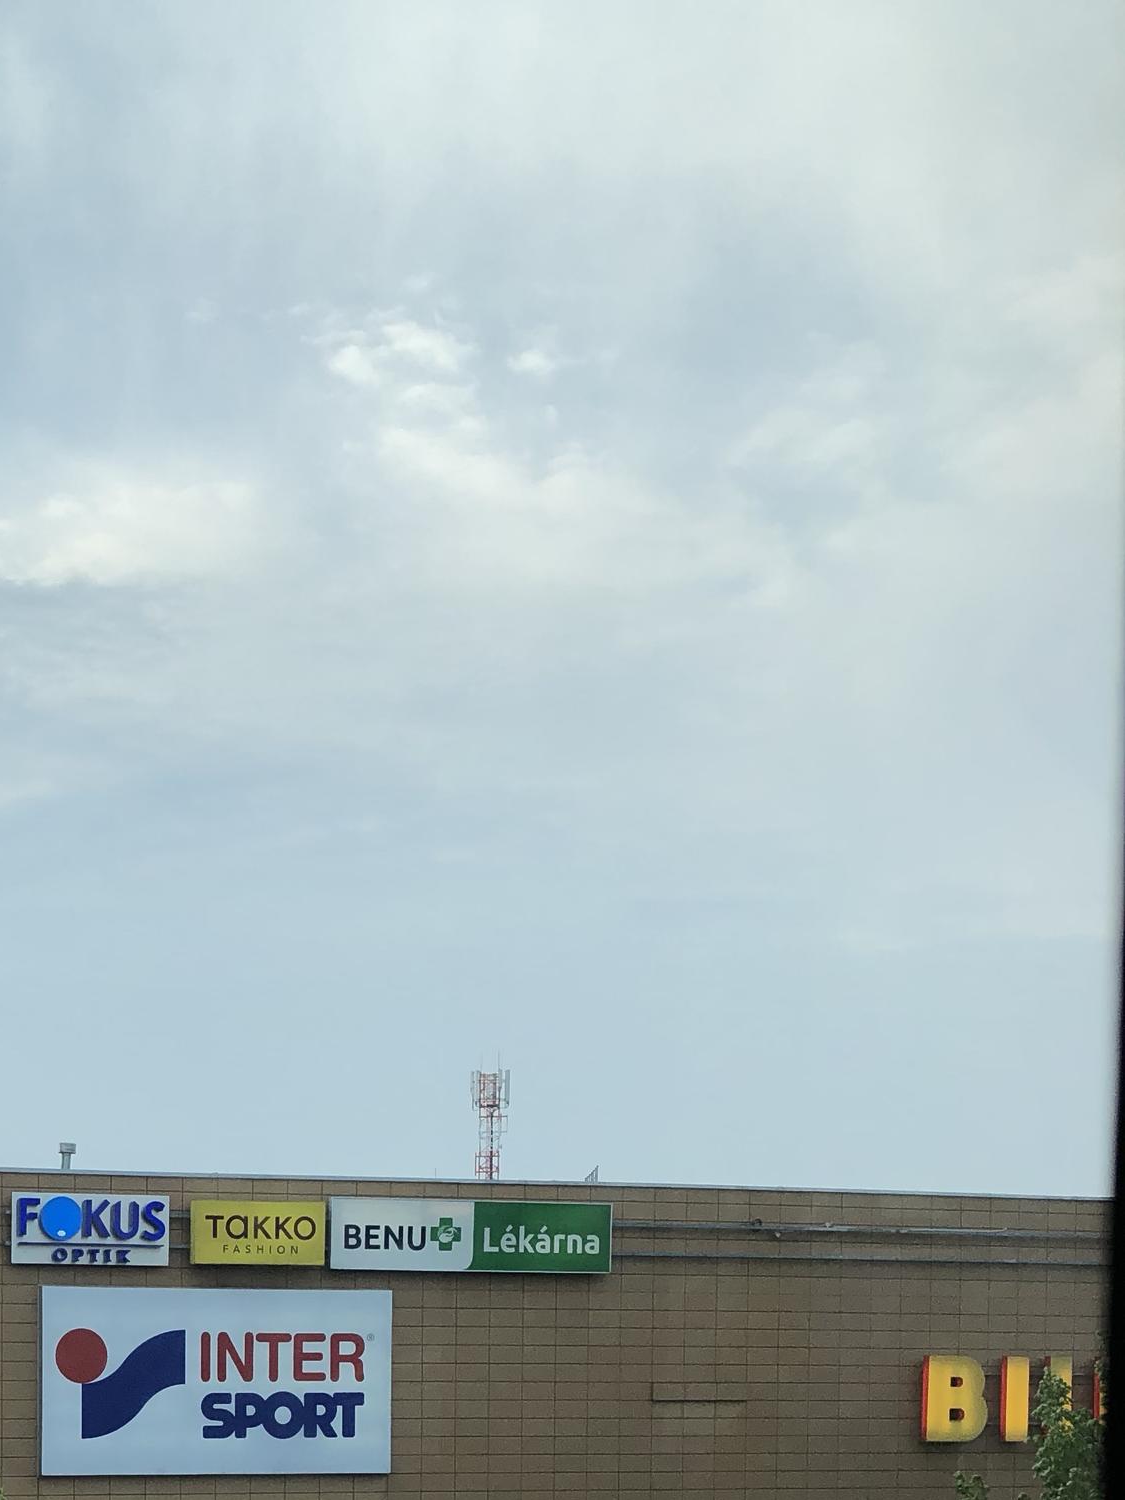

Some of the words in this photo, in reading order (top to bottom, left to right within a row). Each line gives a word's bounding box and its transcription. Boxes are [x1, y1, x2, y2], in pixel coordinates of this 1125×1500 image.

[16, 1196, 166, 1242] FOKUS
[51, 1247, 132, 1264] OPTIK
[223, 1244, 299, 1255] FASHION
[343, 1224, 427, 1251] BENU
[483, 1224, 600, 1255] Lékárna
[200, 1331, 366, 1383] INTER
[201, 1391, 365, 1440] SPORT
